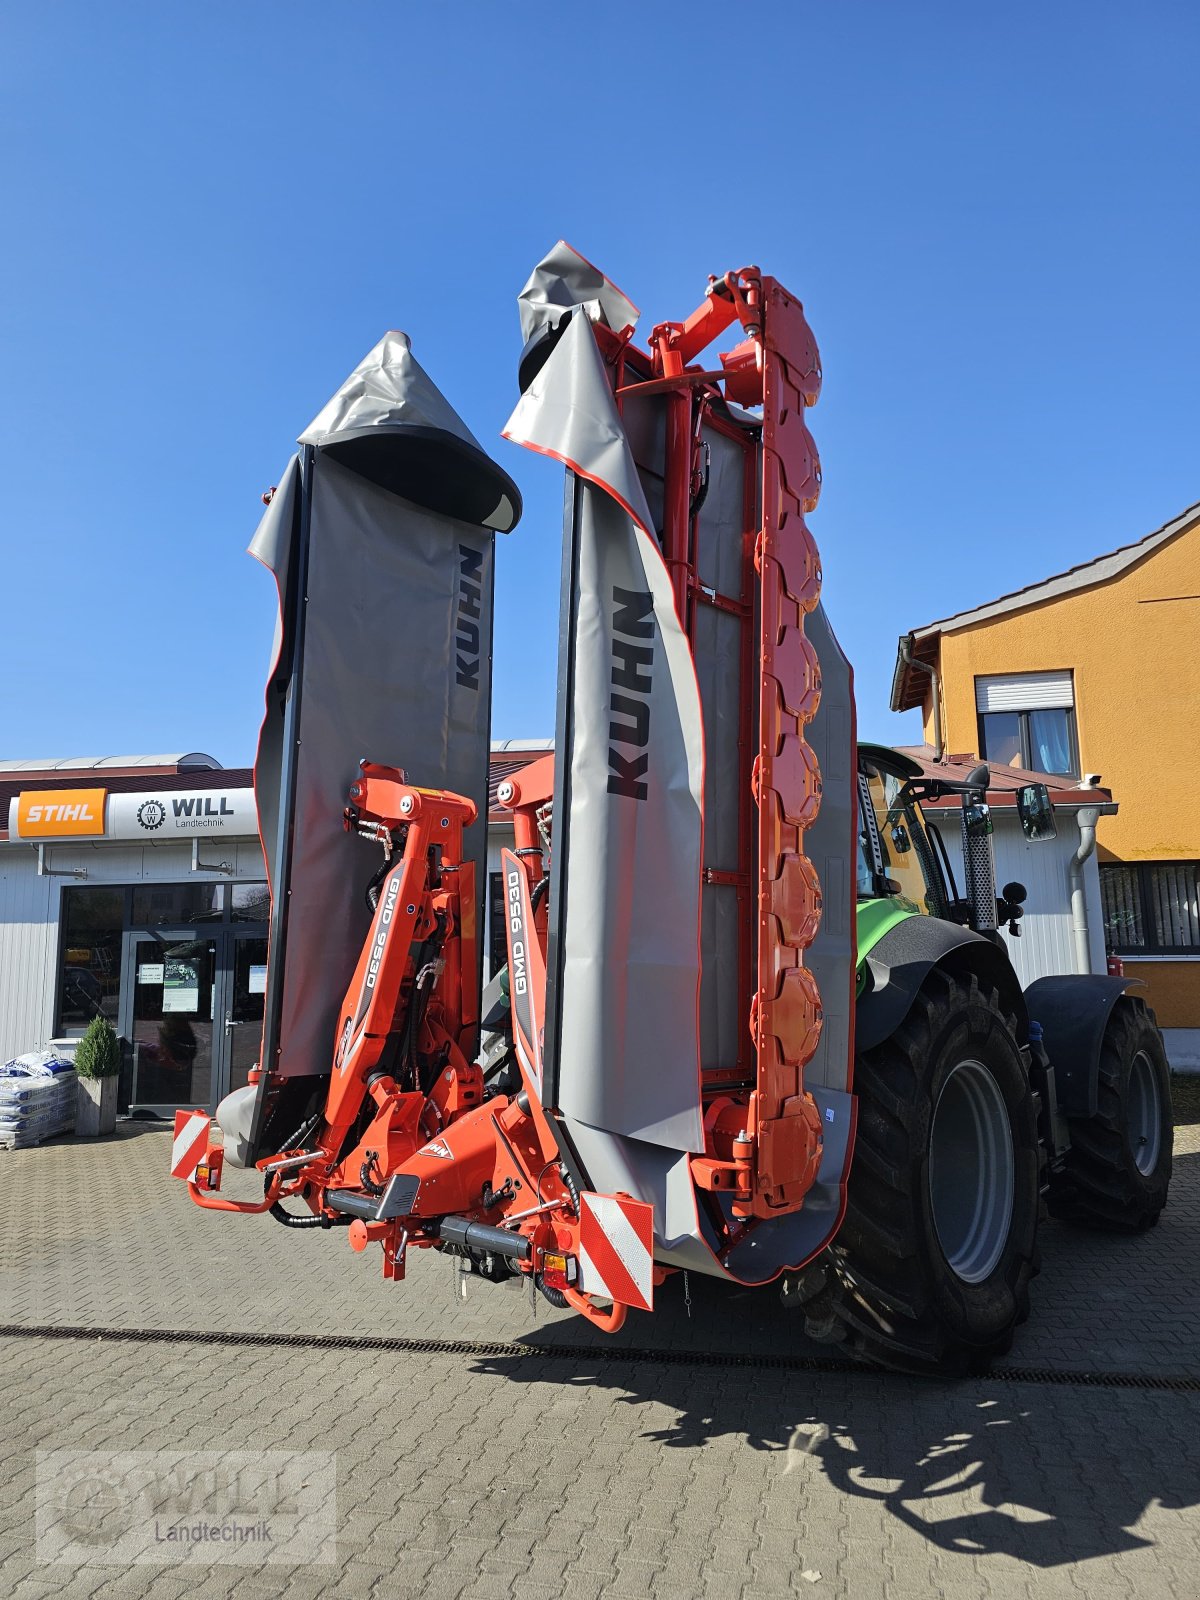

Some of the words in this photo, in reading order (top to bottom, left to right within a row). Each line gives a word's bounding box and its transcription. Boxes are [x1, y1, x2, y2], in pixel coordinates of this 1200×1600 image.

[456, 543, 484, 691] KUHN
[607, 586, 655, 801] KUHN
[26, 804, 94, 823] STIHL
[172, 797, 235, 817] WILL
[175, 818, 225, 828] Landtechnik
[382, 878, 400, 925] GMD
[508, 871, 522, 933] 9530
[366, 932, 387, 988] 9530
[513, 941, 527, 995] GMD
